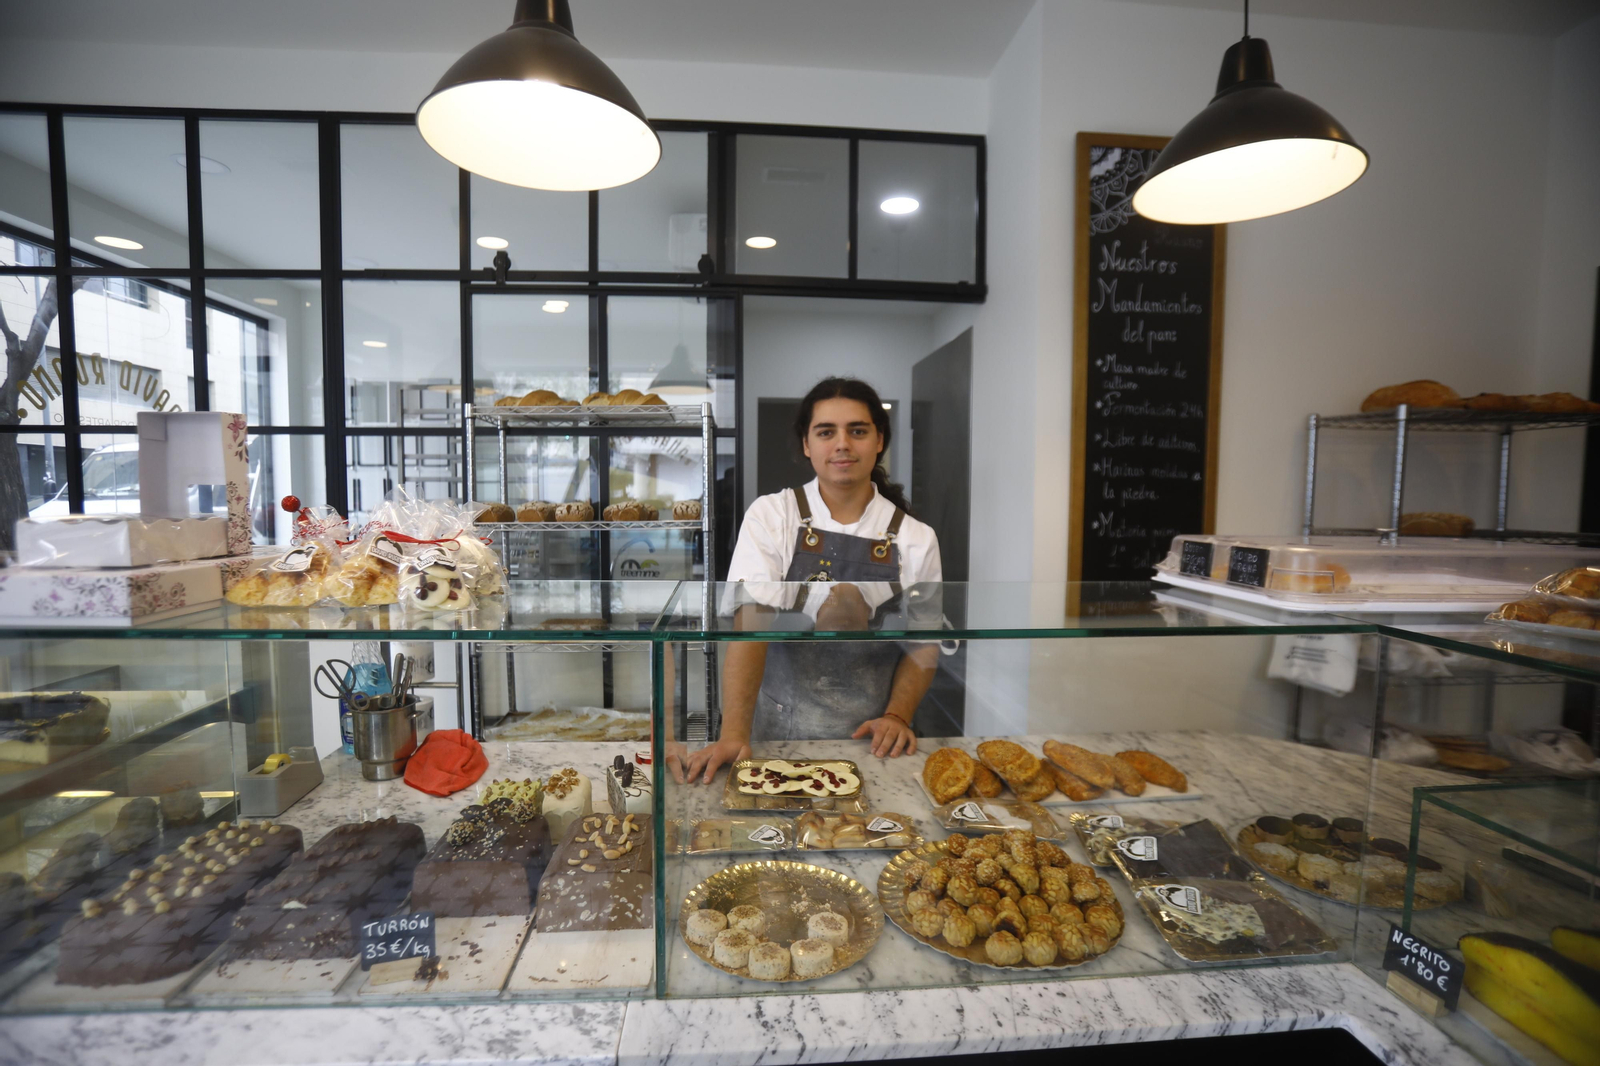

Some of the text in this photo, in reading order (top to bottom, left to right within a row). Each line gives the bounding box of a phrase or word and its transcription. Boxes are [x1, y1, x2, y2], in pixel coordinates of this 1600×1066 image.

[1098, 239, 1178, 275] Nuestros
[1091, 276, 1203, 315] Mandamientos
[1122, 316, 1178, 354] del pan:
[1101, 353, 1188, 379] Masa madre de
[1101, 427, 1136, 449] Libre
[1141, 429, 1155, 446] de
[1101, 456, 1145, 479] Harinas
[1102, 481, 1115, 500] la
[362, 914, 430, 937] TURRÓN
[1392, 929, 1451, 972] NEGRITO
